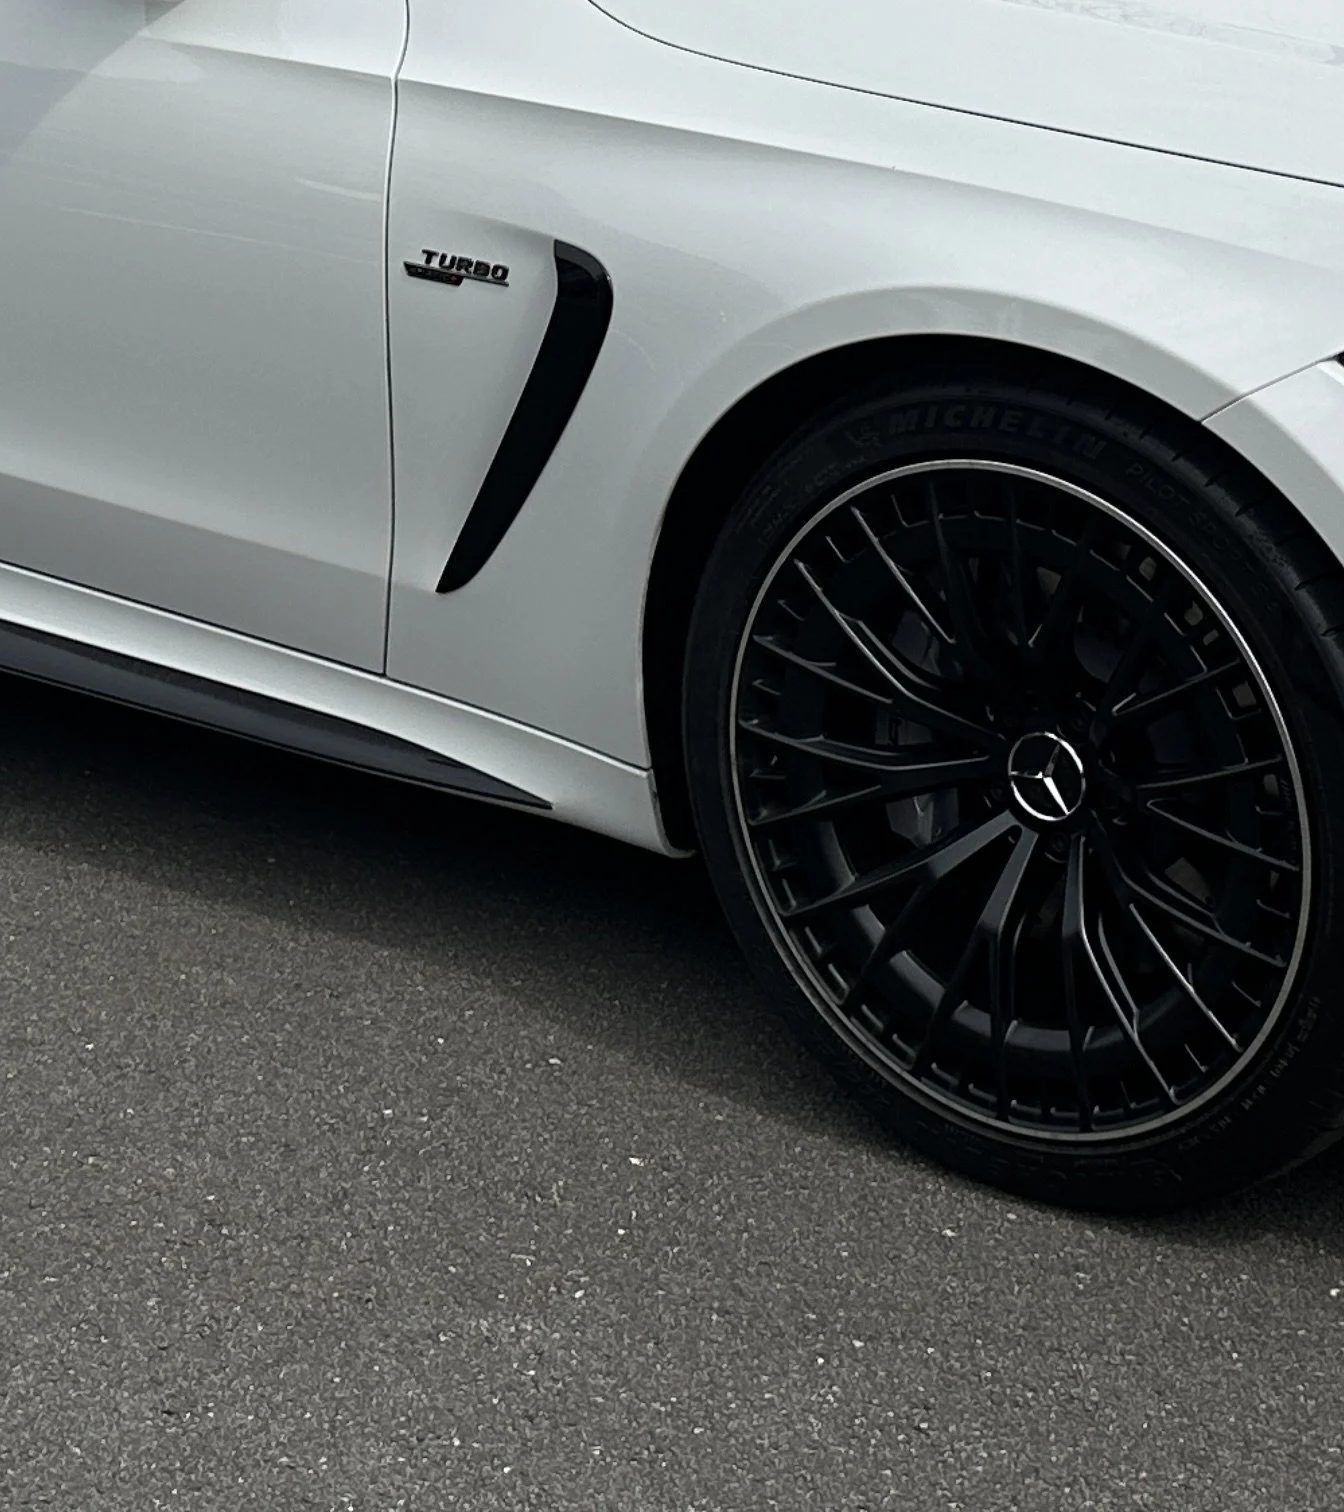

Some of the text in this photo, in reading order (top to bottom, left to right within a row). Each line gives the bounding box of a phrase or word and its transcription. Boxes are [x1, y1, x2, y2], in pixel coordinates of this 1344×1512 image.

[421, 248, 510, 281] TURBO
[888, 402, 1108, 460] MICHELIN
[1125, 461, 1191, 506] PILOT
